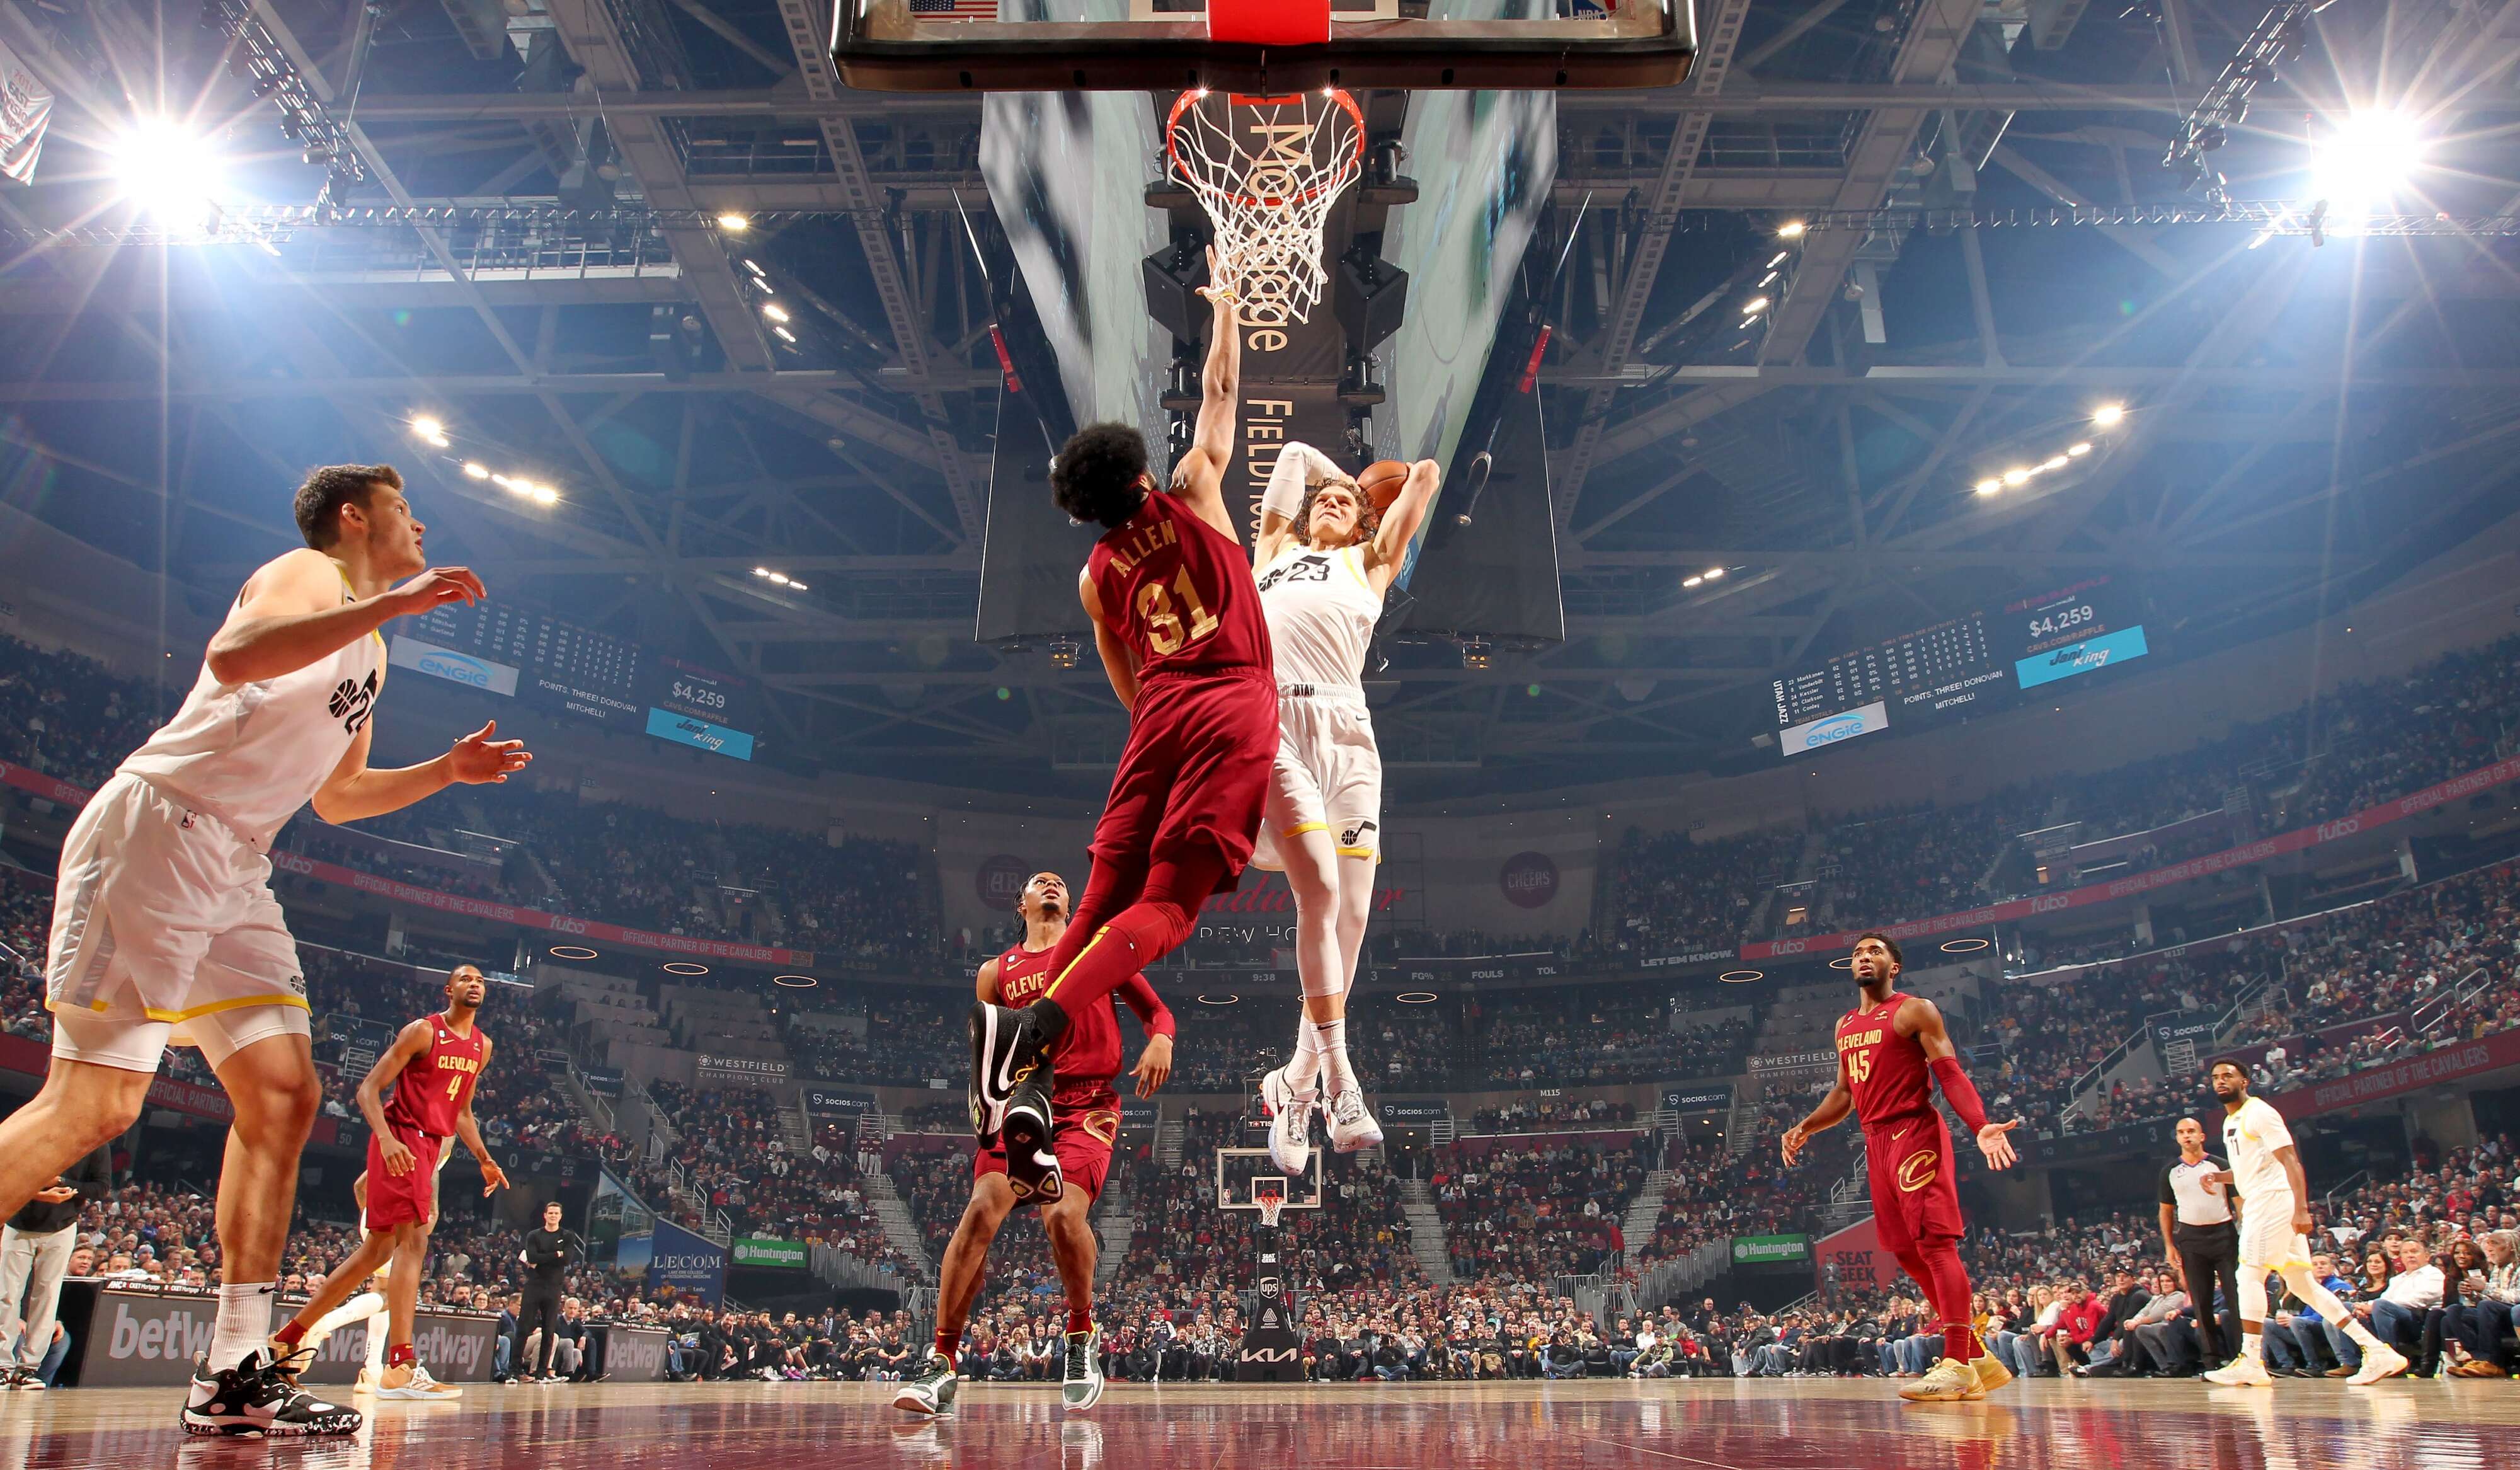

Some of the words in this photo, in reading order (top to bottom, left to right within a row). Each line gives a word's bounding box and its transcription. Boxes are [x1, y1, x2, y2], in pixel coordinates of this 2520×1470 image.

[8, 81, 27, 108] EAST
[1237, 125, 1314, 351] Mortgage
[1247, 399, 1292, 547] FIELD
[1109, 520, 1176, 578] ALLEN
[1288, 561, 1330, 582] 23
[1137, 564, 1218, 655] 31
[2029, 606, 2093, 638] $4,259
[2049, 644, 2086, 666] Jani
[2073, 649, 2110, 667] King
[672, 680, 726, 709] $4,259
[1773, 680, 1785, 702] UTAH
[1904, 691, 1934, 704] POINTS.
[1935, 682, 1963, 696] THREE!
[1964, 670, 2003, 687] DONOVAN
[566, 701, 605, 719] MITCHELL!
[572, 688, 598, 704] THREE!
[600, 696, 637, 713] DONOVAN
[1802, 694, 1823, 704] Clarkson
[1935, 692, 1975, 709] MITCHELL!
[345, 691, 374, 736] 2
[1777, 703, 1789, 725] JAZZ
[1794, 714, 1811, 725] TEAM
[55, 784, 88, 805] OFFICI
[2317, 818, 2358, 841] fubo
[2401, 788, 2444, 813] OFFICIAL
[2445, 770, 2491, 794] PARTNER
[2494, 765, 2507, 780] OF
[271, 851, 313, 874] fubo
[353, 873, 391, 894] OFFICIAL
[394, 887, 432, 905] PARTNER
[434, 895, 447, 906] OF
[449, 898, 465, 911] THE
[467, 902, 515, 920] CAVALIERS
[1508, 872, 1550, 888] CHEERS
[2030, 896, 2069, 913] fubo
[2109, 880, 2147, 896] OFFICIAL
[2150, 866, 2191, 885] PARTNER
[2192, 862, 2203, 874] OF
[2205, 857, 2221, 870] THE
[2224, 842, 2276, 866] CAVALIERS
[549, 915, 585, 934] fubo
[622, 931, 658, 947] OFFICIAL
[661, 936, 697, 952] PARTNER
[700, 942, 711, 953] OF
[713, 944, 728, 956] THE
[730, 946, 773, 960] CAVALIERS
[1771, 941, 1804, 955] fubo
[1920, 922, 1930, 934] OF
[1933, 919, 1948, 931] THE
[1950, 910, 1995, 927] CAVALIERS
[1641, 958, 1666, 967] LET
[1668, 955, 1688, 964] EM
[1690, 950, 1734, 963] KNOW.
[1176, 973, 1183, 983] 5
[1370, 971, 1378, 981] 3
[1412, 972, 1434, 980] FG%
[1472, 970, 1504, 979] FOULS
[1537, 966, 1557, 975] TOL
[1006, 971, 1048, 1001] CLEVE
[1838, 1030, 1882, 1053] CLEVELAND
[438, 1055, 478, 1074] CLEVLA
[714, 1059, 785, 1072] WESTFIELD
[1765, 1052, 1836, 1065] WESTFIELD
[1848, 1049, 1870, 1083] 45
[699, 1072, 755, 1081] CHAMPIONS
[1753, 1069, 1809, 1079] CHAMPIONS
[2315, 1083, 2351, 1106] OFFICIAL
[2355, 1072, 2395, 1095] PARTNER
[2398, 1068, 2408, 1085] OF
[2412, 1062, 2431, 1081] THE
[2432, 1045, 2489, 1076] CAVALIERS
[151, 1081, 186, 1105] OFFICIAL
[189, 1089, 227, 1115] PARTNER
[446, 1074, 462, 1101] 4
[339, 1134, 352, 1146] 50
[2149, 1128, 2158, 1142] 3
[509, 1153, 518, 1168] 0
[562, 1166, 573, 1176] 25
[750, 1246, 804, 1263] Huntington
[1749, 1242, 1804, 1256] Huntington
[1836, 1251, 1873, 1266] SEAT
[1838, 1267, 1878, 1282] GEEK
[1262, 1283, 1278, 1295] ups
[108, 1304, 215, 1360] betw
[413, 1326, 485, 1374] etway
[607, 1333, 662, 1377] betway
[1242, 1348, 1297, 1362] KIA
